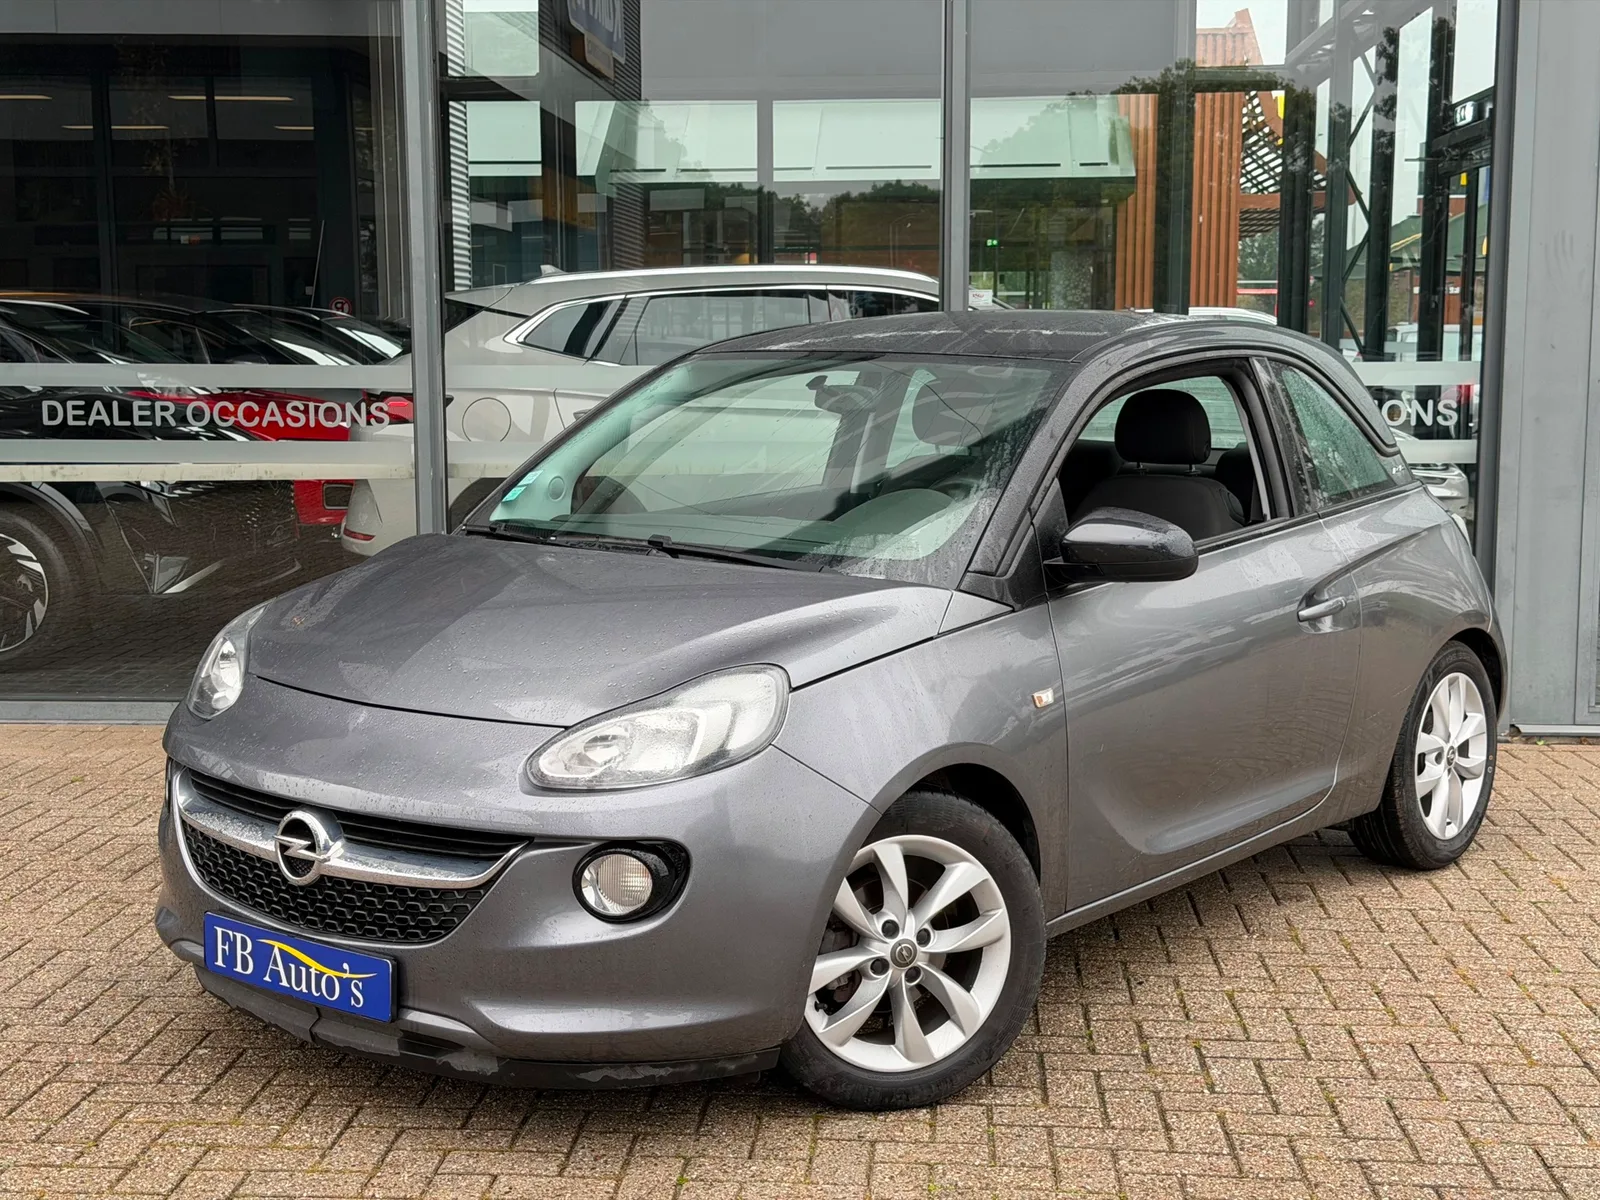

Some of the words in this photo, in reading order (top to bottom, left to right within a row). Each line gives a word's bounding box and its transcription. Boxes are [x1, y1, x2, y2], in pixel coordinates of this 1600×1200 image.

[42, 400, 176, 427] DEALER
[186, 400, 390, 428] OCCASIONS
[1374, 399, 1458, 426] ONS
[214, 926, 254, 975] FB
[263, 944, 363, 1008] Auto's
